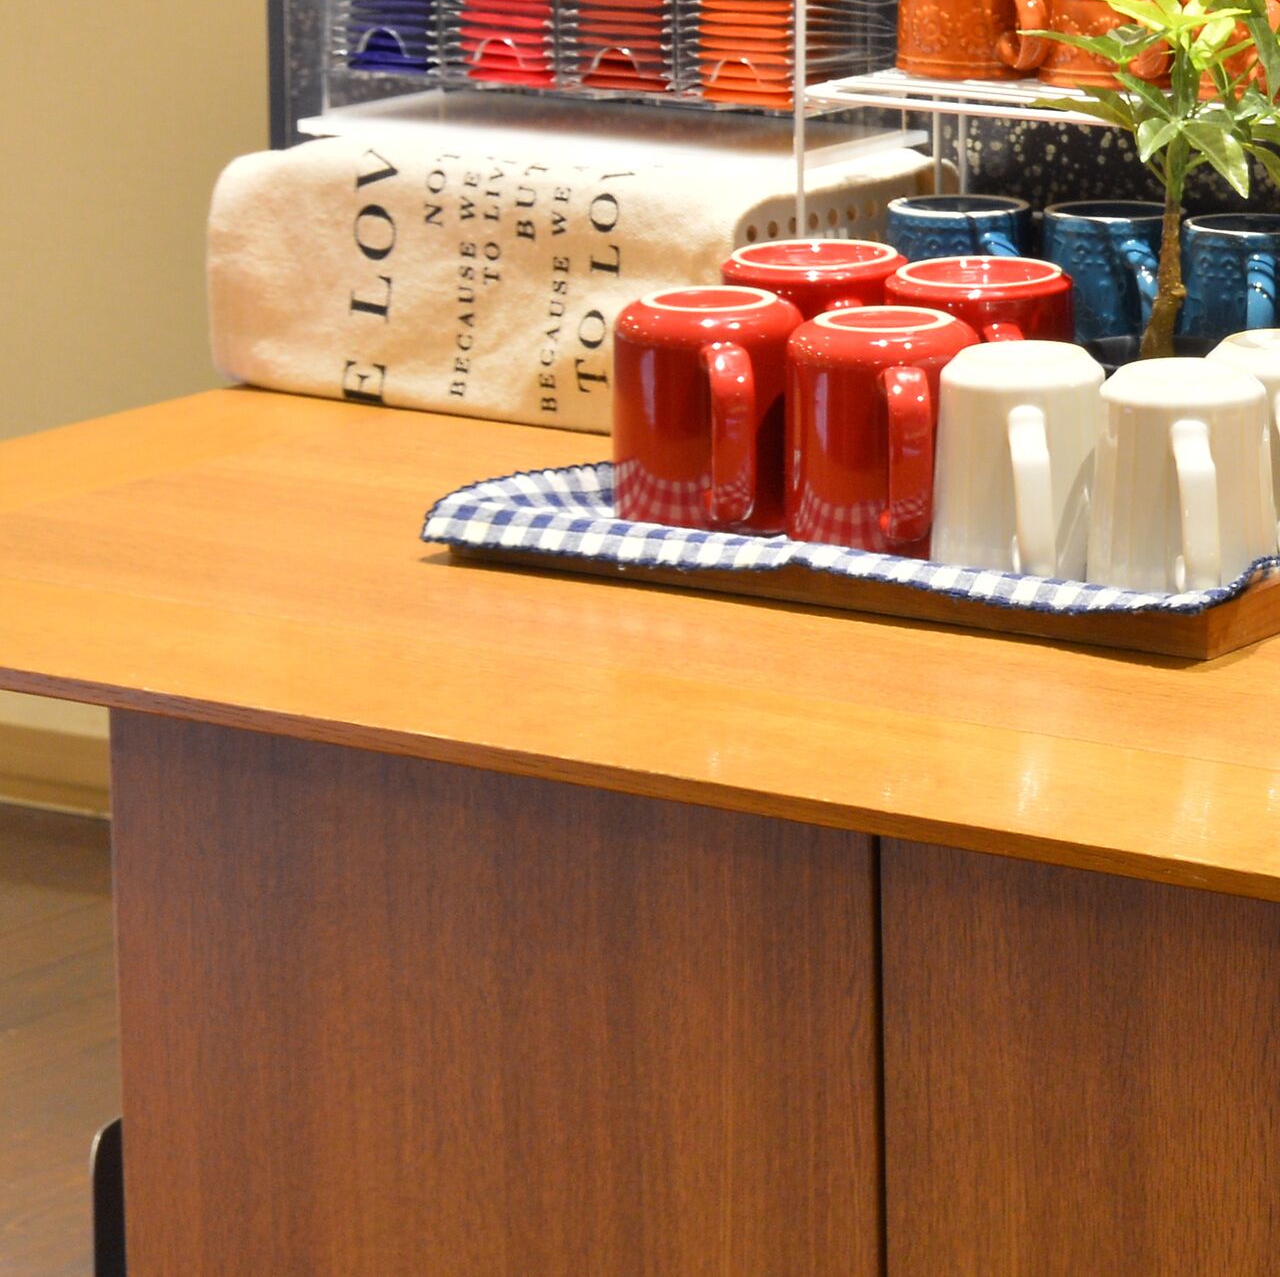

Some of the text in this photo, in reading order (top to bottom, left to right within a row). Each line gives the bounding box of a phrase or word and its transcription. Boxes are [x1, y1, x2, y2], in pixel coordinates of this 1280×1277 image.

[450, 171, 482, 398] BECAUSE WE
[483, 241, 501, 286] TO
[540, 186, 572, 413] BECAUSE WE
[574, 310, 610, 394] TO
